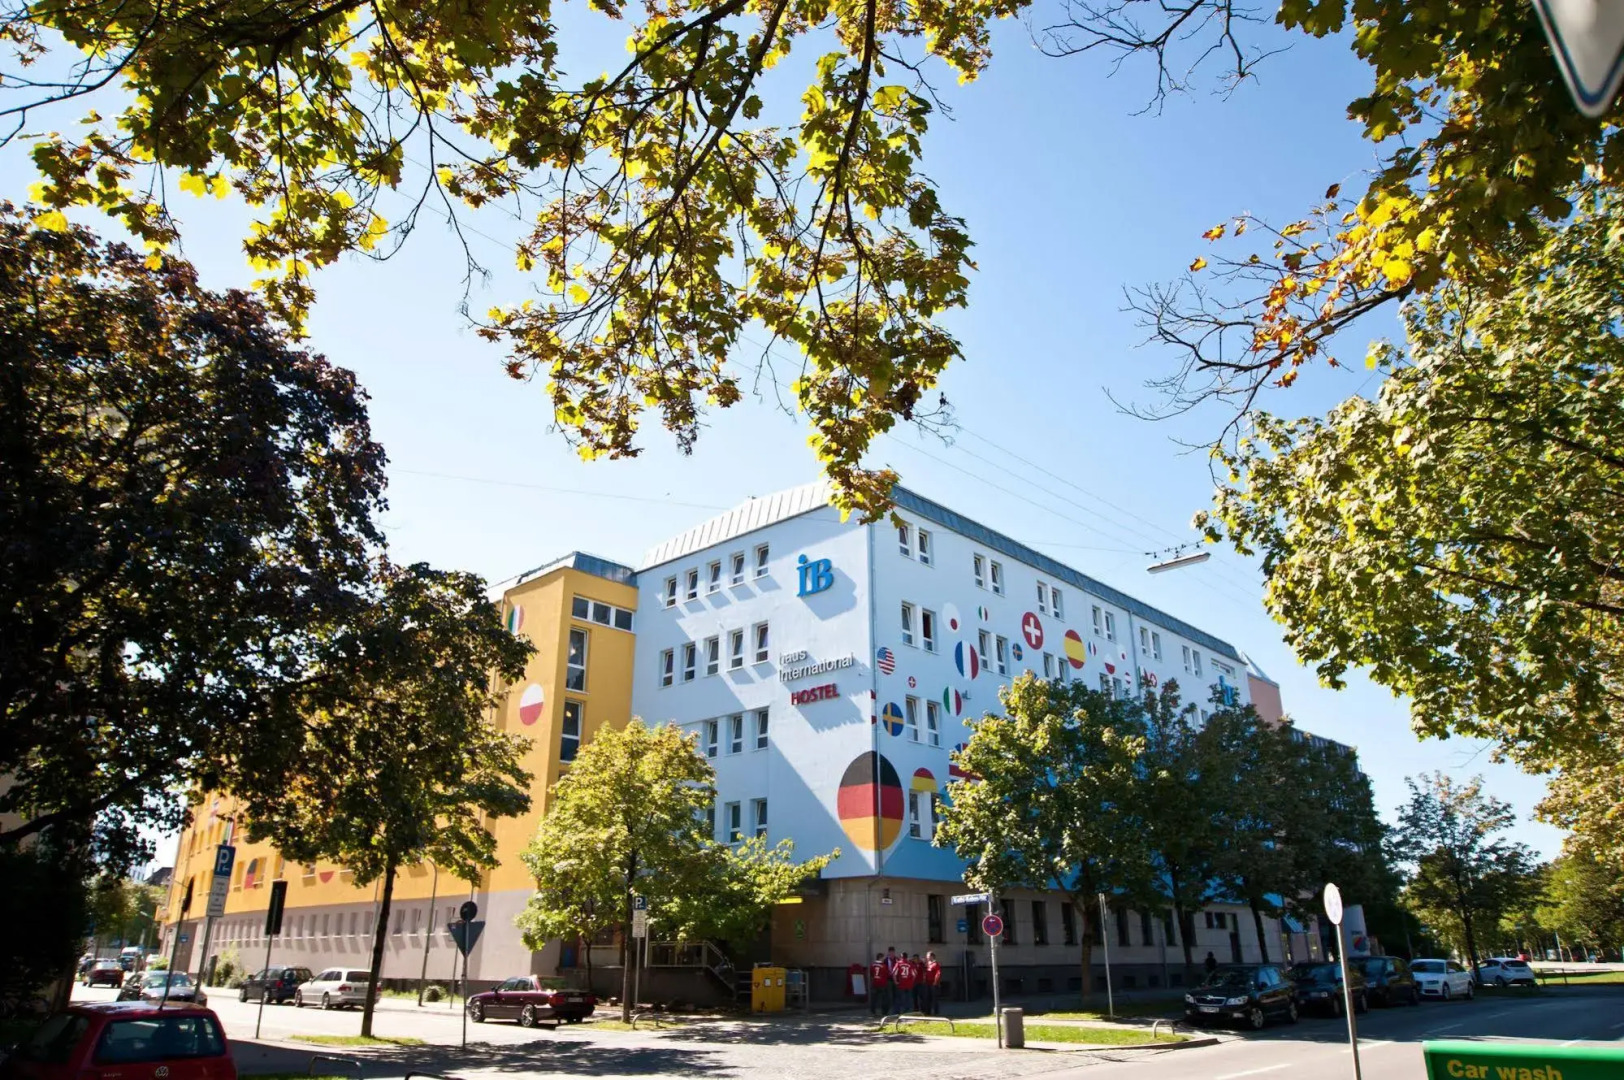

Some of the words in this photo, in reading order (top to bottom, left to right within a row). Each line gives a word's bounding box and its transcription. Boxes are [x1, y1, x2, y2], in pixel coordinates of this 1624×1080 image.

[791, 683, 840, 705] HOSTEL
[217, 849, 230, 872] P
[635, 897, 643, 909] P
[1447, 1059, 1488, 1079] Car
[1496, 1065, 1563, 1080] wash
